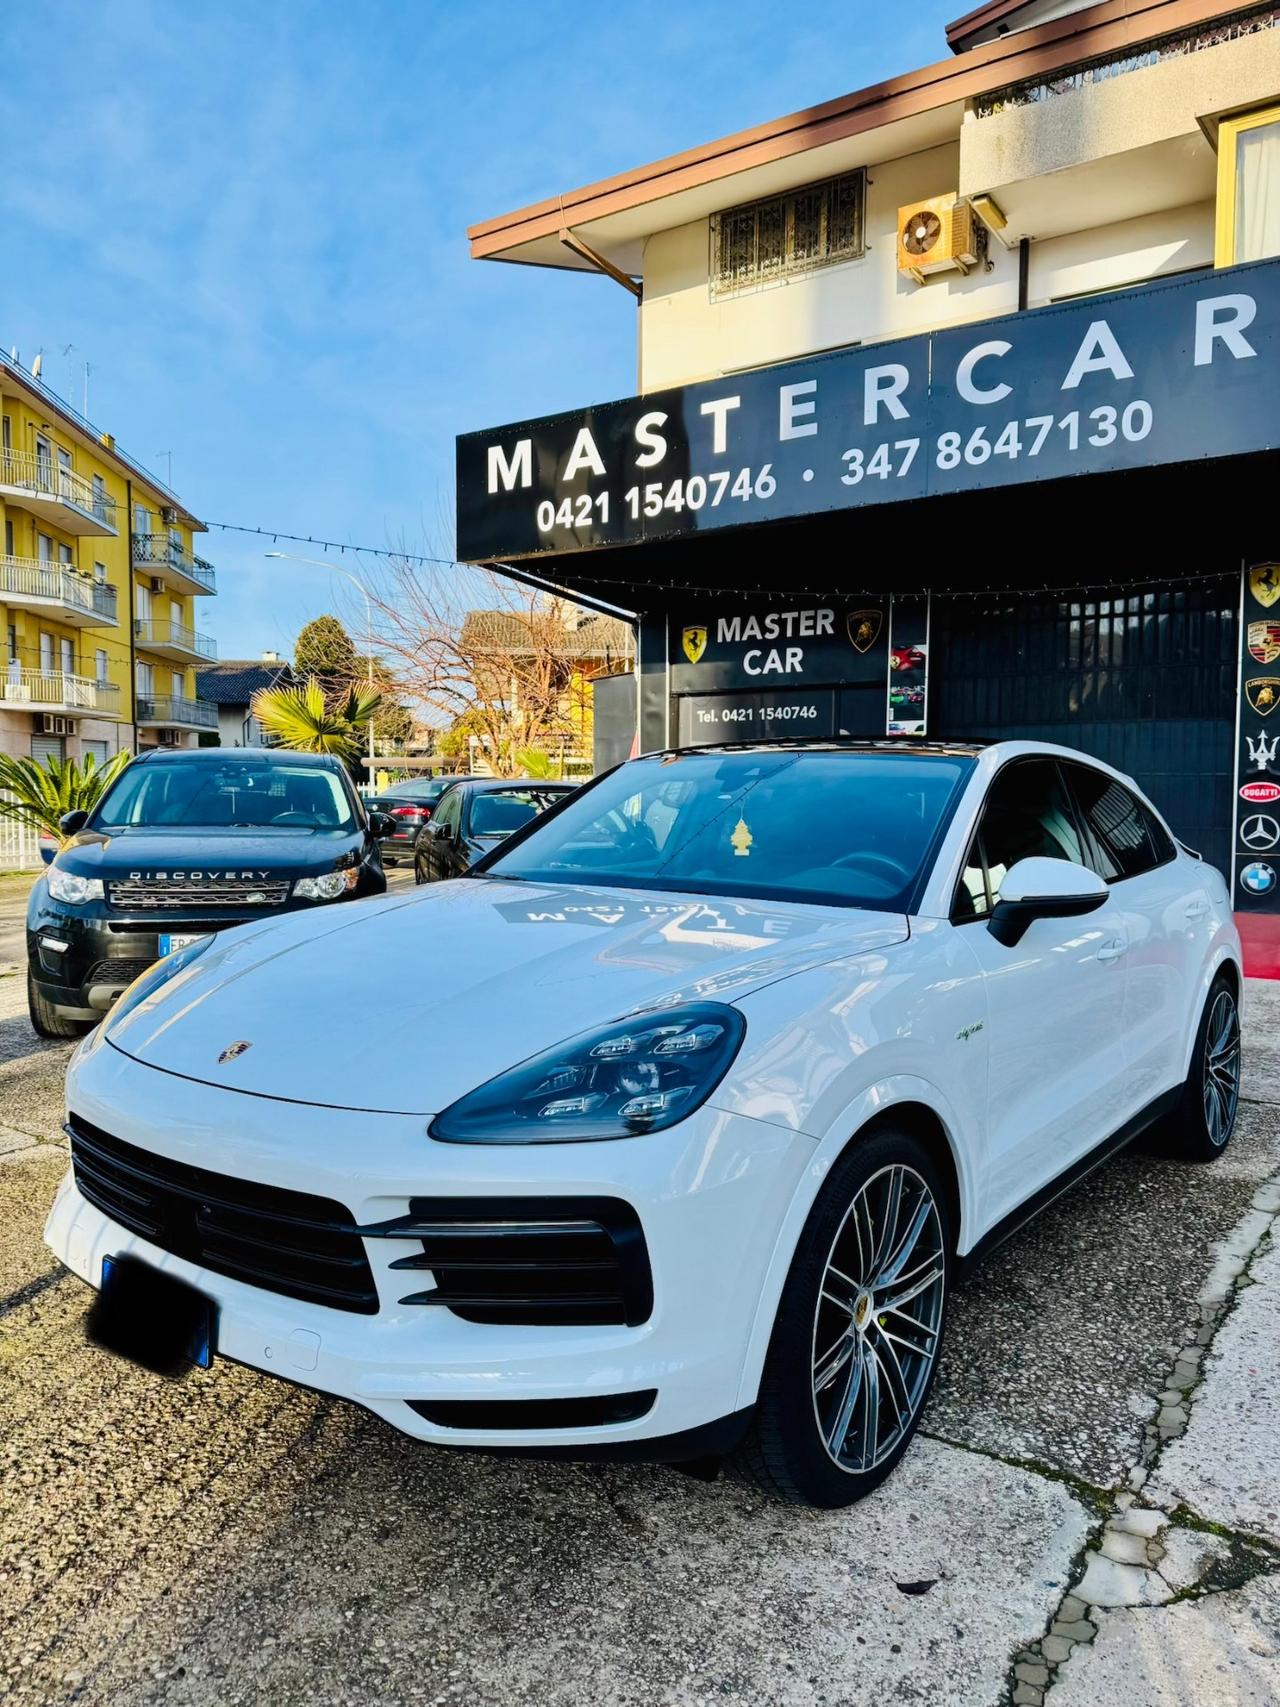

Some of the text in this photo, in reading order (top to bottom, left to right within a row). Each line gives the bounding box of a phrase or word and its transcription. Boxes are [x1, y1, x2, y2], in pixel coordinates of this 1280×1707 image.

[536, 399, 1153, 532] 0421 1540746 347 8647130
[716, 608, 835, 643] MASTER
[743, 647, 804, 676] CAR
[697, 705, 818, 723] Tel. 0421 1540746
[1243, 788, 1278, 797] BUGATTI
[129, 871, 270, 880] DISCOVERY
